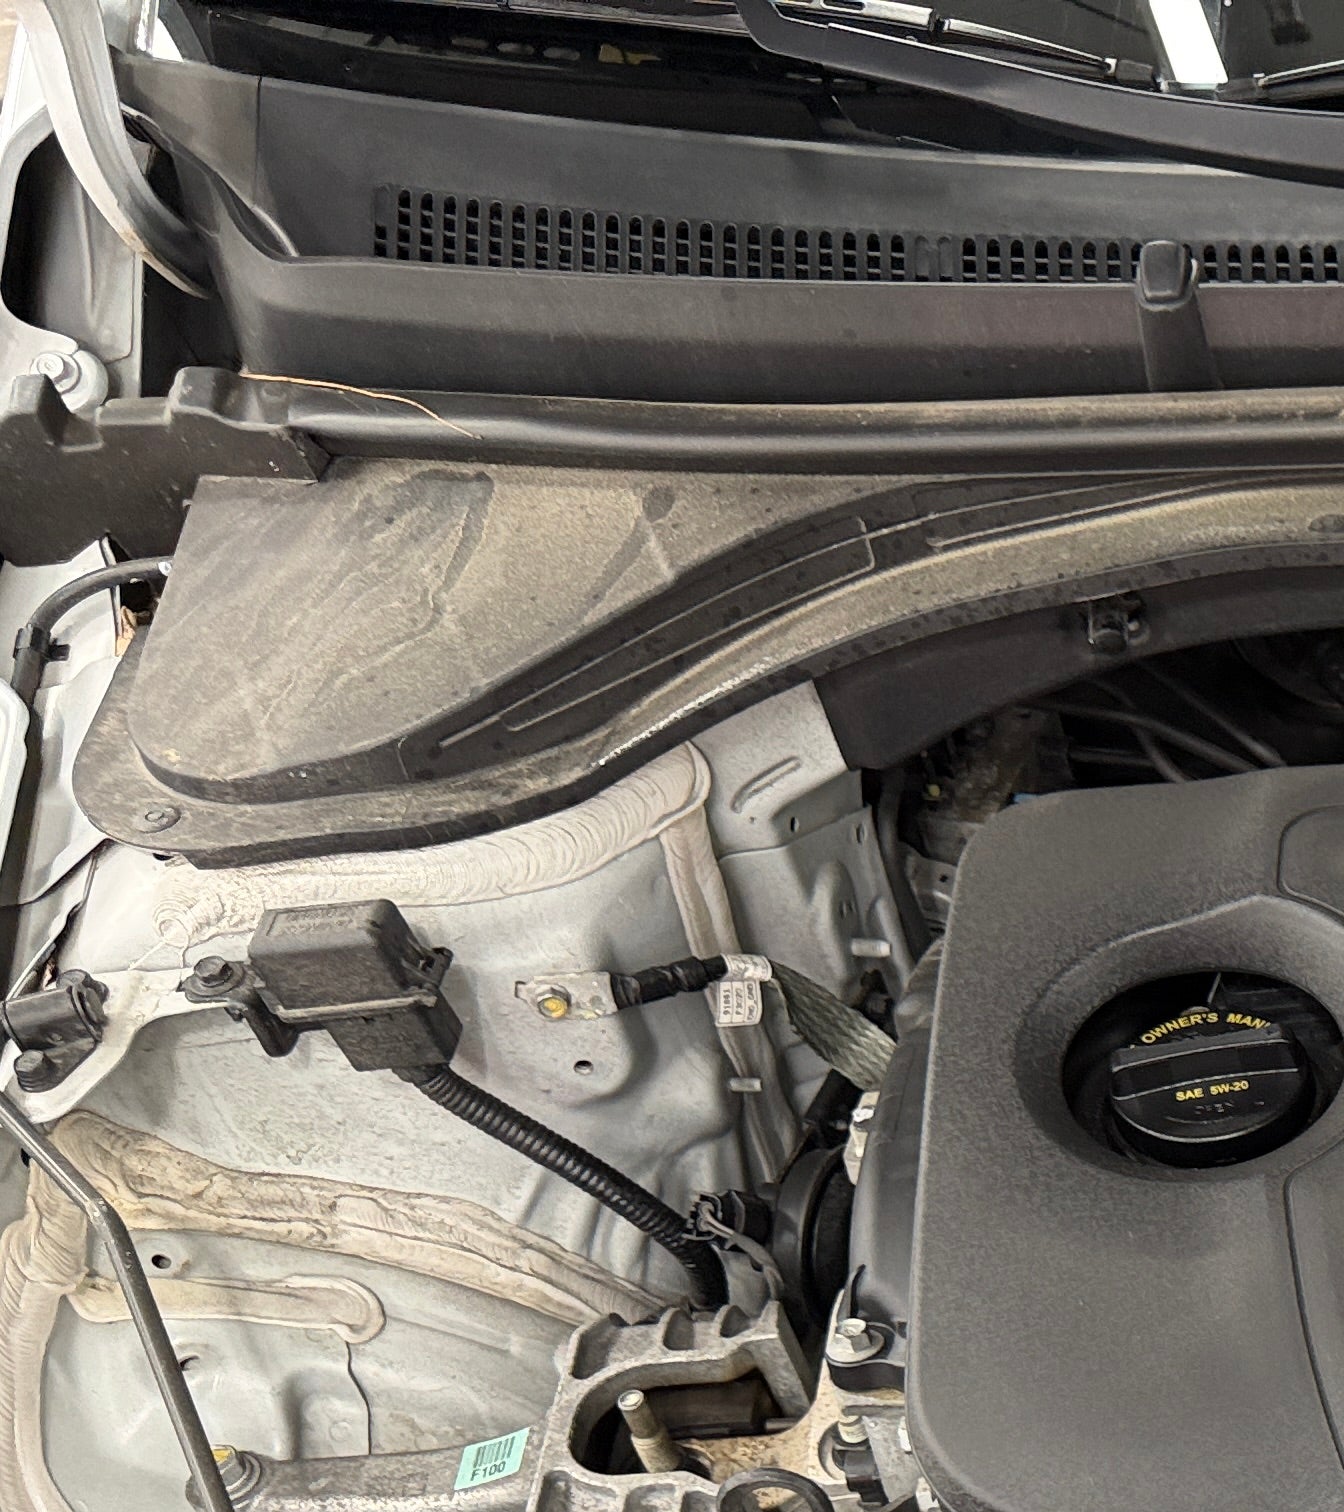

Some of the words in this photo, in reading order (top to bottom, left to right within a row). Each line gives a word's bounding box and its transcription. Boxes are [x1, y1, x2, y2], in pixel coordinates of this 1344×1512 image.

[1140, 1012, 1219, 1045] OWNER'S
[1226, 1012, 1273, 1031] MAN
[1175, 1087, 1205, 1102] SAE
[1209, 1080, 1250, 1097] 5W-20
[470, 1460, 507, 1481] F100
